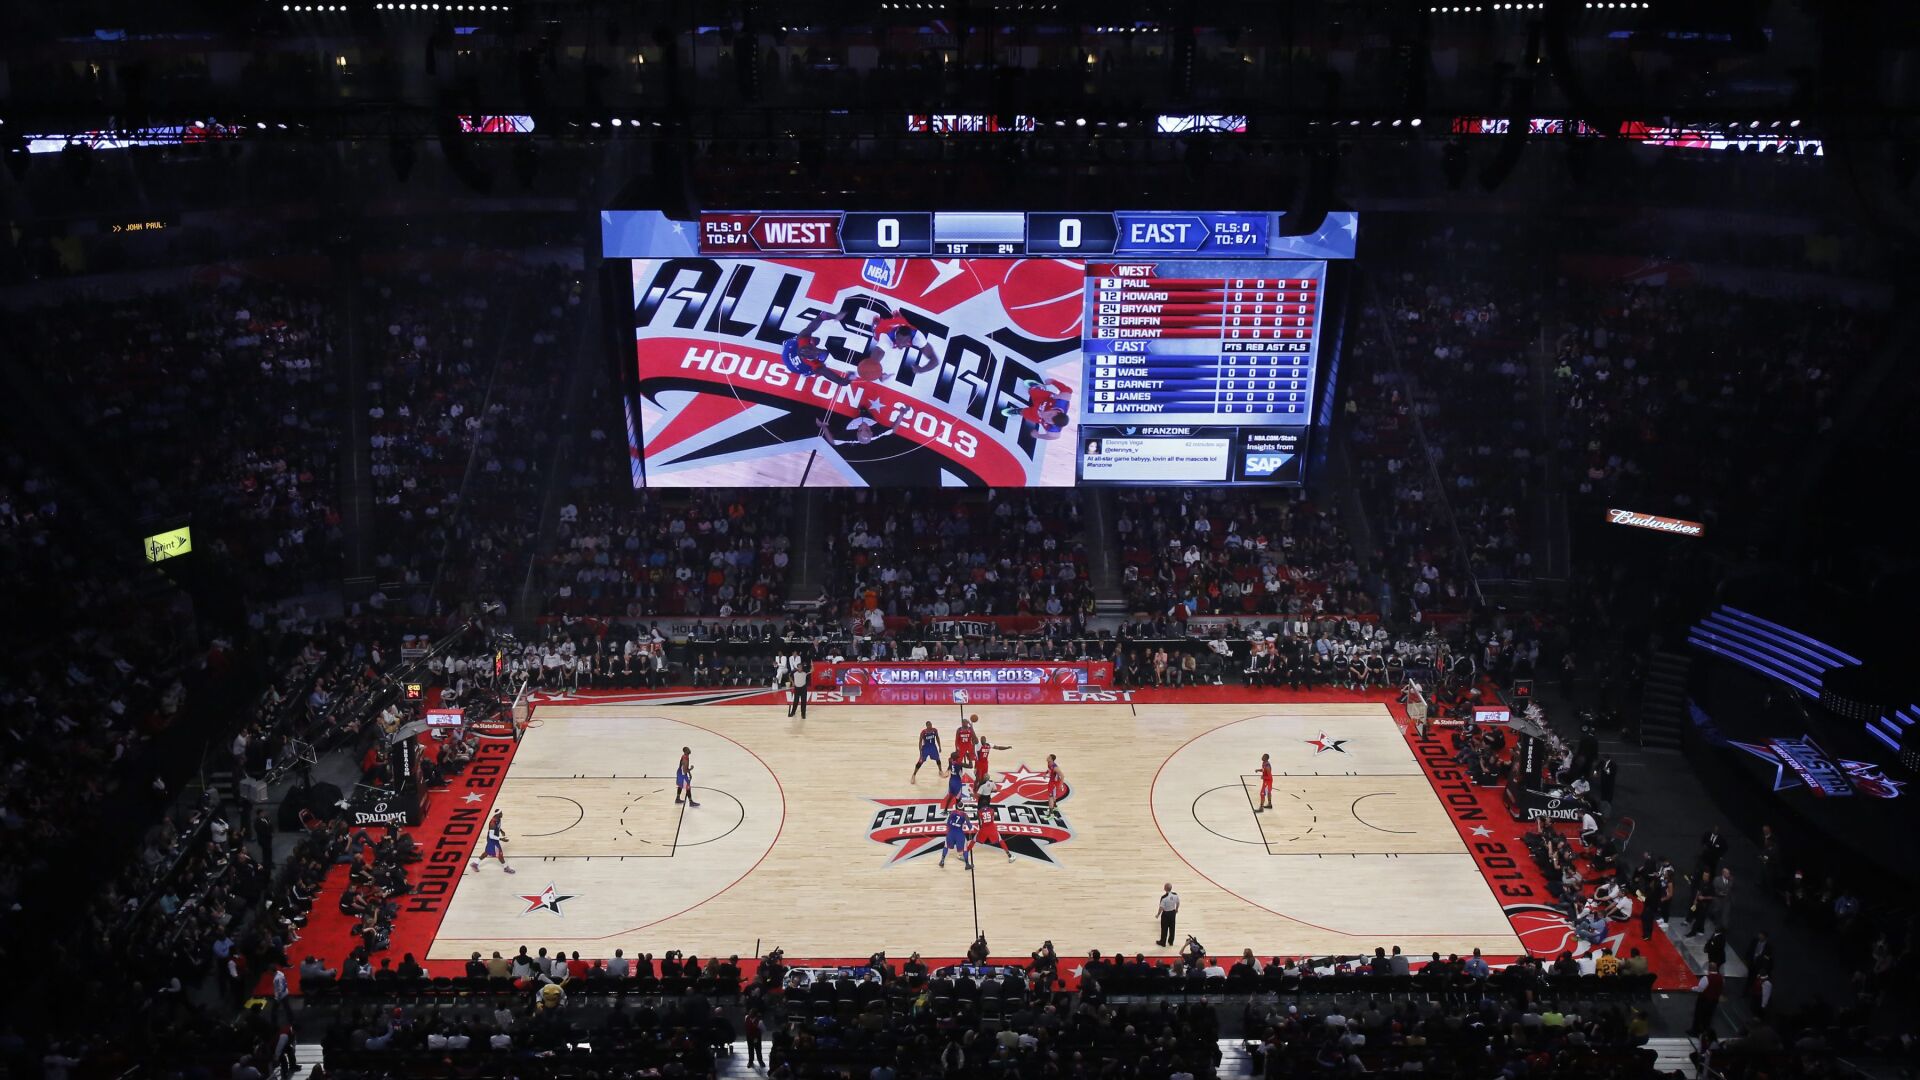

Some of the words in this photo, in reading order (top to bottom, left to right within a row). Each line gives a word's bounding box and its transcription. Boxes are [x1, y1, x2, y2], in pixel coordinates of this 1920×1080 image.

[707, 222, 732, 232] FLS:
[734, 222, 742, 232] 0
[1216, 223, 1240, 233] FLS:
[1242, 224, 1250, 232] 0
[764, 222, 831, 244] WEST
[877, 218, 900, 248] 0
[1058, 218, 1082, 248] 0
[1131, 224, 1192, 244] EAST
[707, 234, 726, 244] TO:
[726, 234, 748, 244] 6/1
[1215, 234, 1234, 244] TO:
[1236, 234, 1257, 244] 6/1
[947, 244, 968, 254] 1ST
[998, 244, 1014, 254] 24
[866, 266, 890, 284] NBA
[1118, 266, 1152, 276] WEST
[1123, 280, 1150, 288] PAUL
[1236, 280, 1243, 288] 0
[1257, 280, 1264, 288] 0
[1278, 280, 1285, 288] 0
[1301, 280, 1308, 288] 0
[1104, 292, 1117, 300] 12
[1122, 292, 1168, 300] HOWARD
[1235, 293, 1242, 301] 0
[1256, 293, 1263, 301] 0
[1276, 293, 1284, 301] 0
[1300, 293, 1307, 301] 0
[1234, 305, 1241, 314] 0
[1255, 305, 1262, 314] 0
[1275, 305, 1282, 314] 0
[1298, 305, 1305, 314] 0
[1121, 317, 1161, 325] GRIFFIN
[1233, 317, 1240, 326] 0
[1253, 317, 1260, 326] 0
[1274, 317, 1281, 326] 0
[1297, 317, 1304, 326] 0
[1120, 329, 1162, 337] DURANT
[1232, 330, 1239, 338] 0
[1252, 330, 1259, 338] 0
[1273, 330, 1280, 338] 0
[1296, 330, 1303, 338] 0
[1115, 342, 1147, 352] EAST
[1118, 356, 1146, 364] BOSH
[1118, 368, 1148, 376] WADE
[1229, 369, 1235, 377] 0
[1249, 369, 1256, 377] 0
[1270, 369, 1276, 377] 0
[1292, 369, 1298, 377] 0
[1117, 380, 1164, 388] GARNETT
[1228, 381, 1234, 389] 0
[1248, 381, 1254, 389] 0
[1269, 381, 1275, 389] 0
[1291, 381, 1297, 389] 0
[681, 347, 864, 410] HOUSTON
[889, 402, 980, 460] 2013
[1247, 457, 1281, 472] SAP
[1610, 508, 1700, 534] Budweiser
[150, 541, 175, 555] Sprint
[891, 670, 920, 682] NBA
[924, 670, 992, 682] ALL-STAR
[997, 670, 1034, 682] 2013
[1062, 690, 1136, 702] EAST
[872, 804, 1068, 830] ALLSTAR
[1410, 733, 1488, 821] HOUSTON
[1474, 842, 1534, 897] 2013
[1528, 808, 1578, 820] SPALDING
[406, 808, 481, 913] HOUSTON
[466, 744, 511, 788] 2013
[898, 824, 980, 835] HOUSON
[996, 824, 1043, 835] 2013
[1603, 964, 1617, 974] 23
